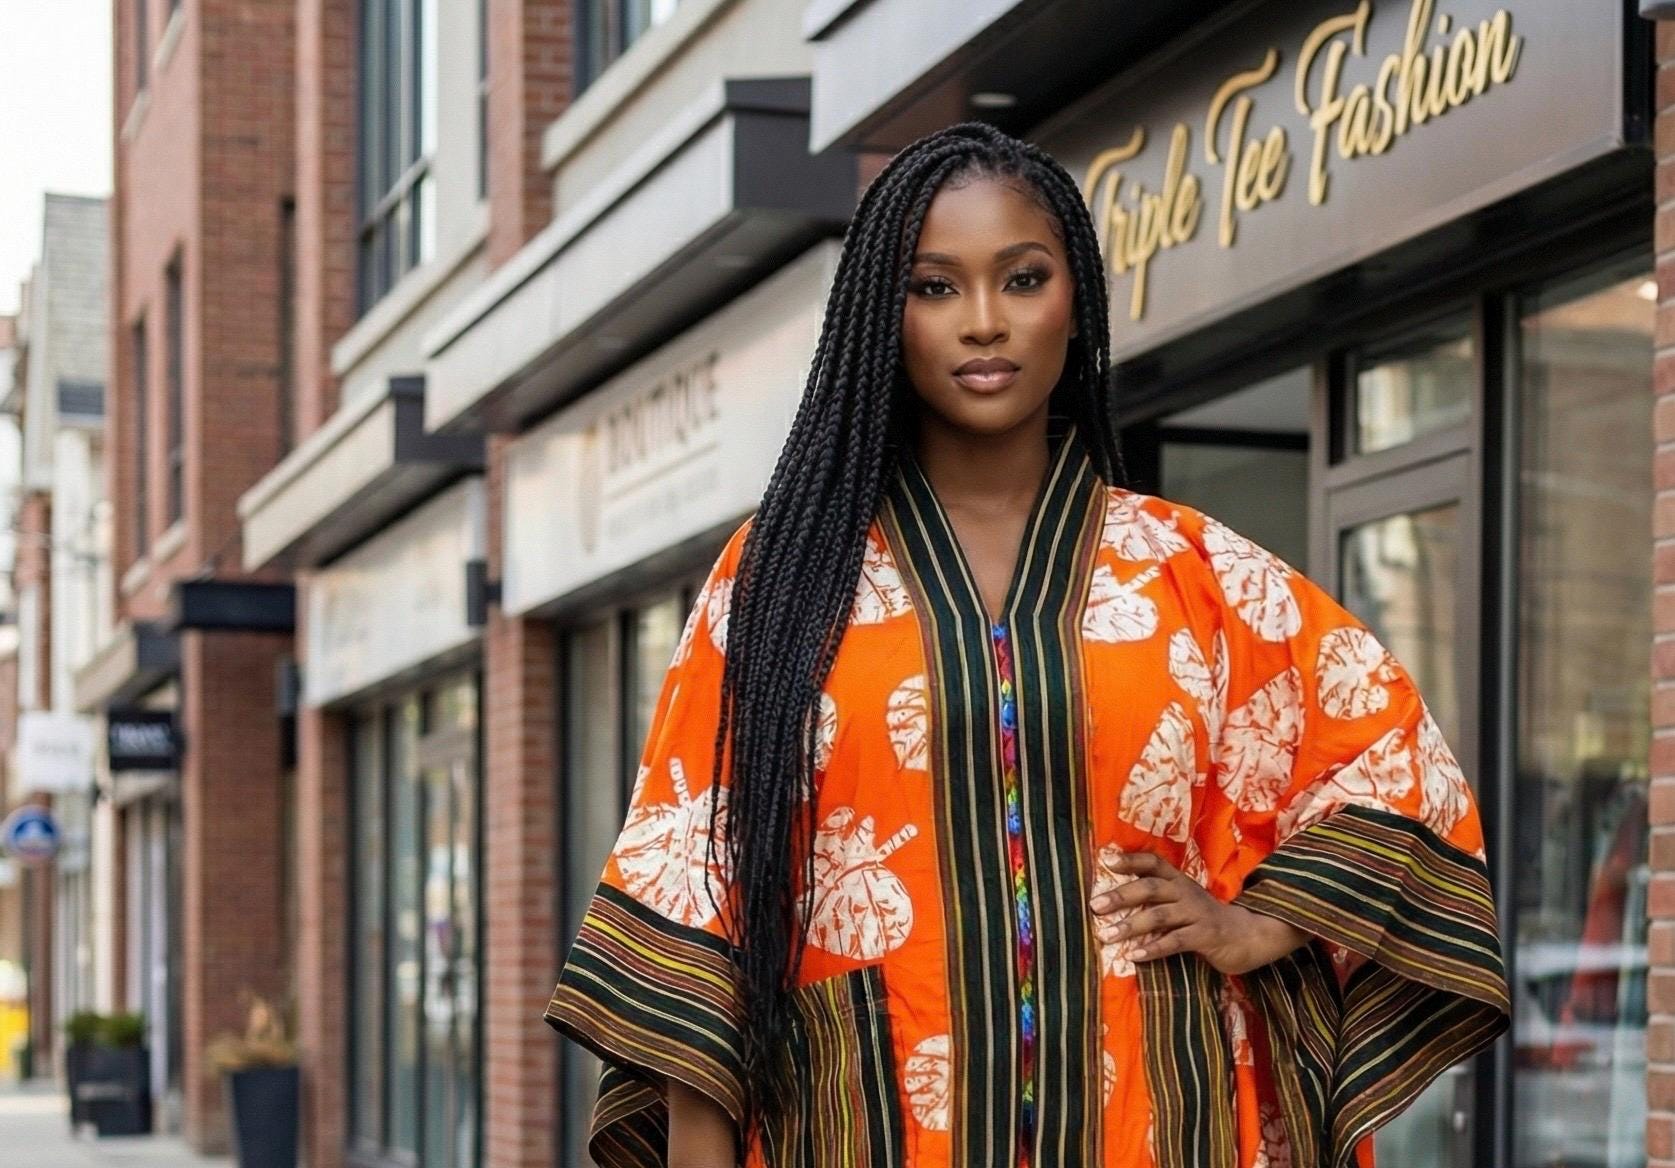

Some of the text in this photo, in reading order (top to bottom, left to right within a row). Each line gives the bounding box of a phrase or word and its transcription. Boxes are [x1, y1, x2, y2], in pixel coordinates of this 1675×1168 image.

[1084, 0, 1524, 321] Triple Tee Fashion
